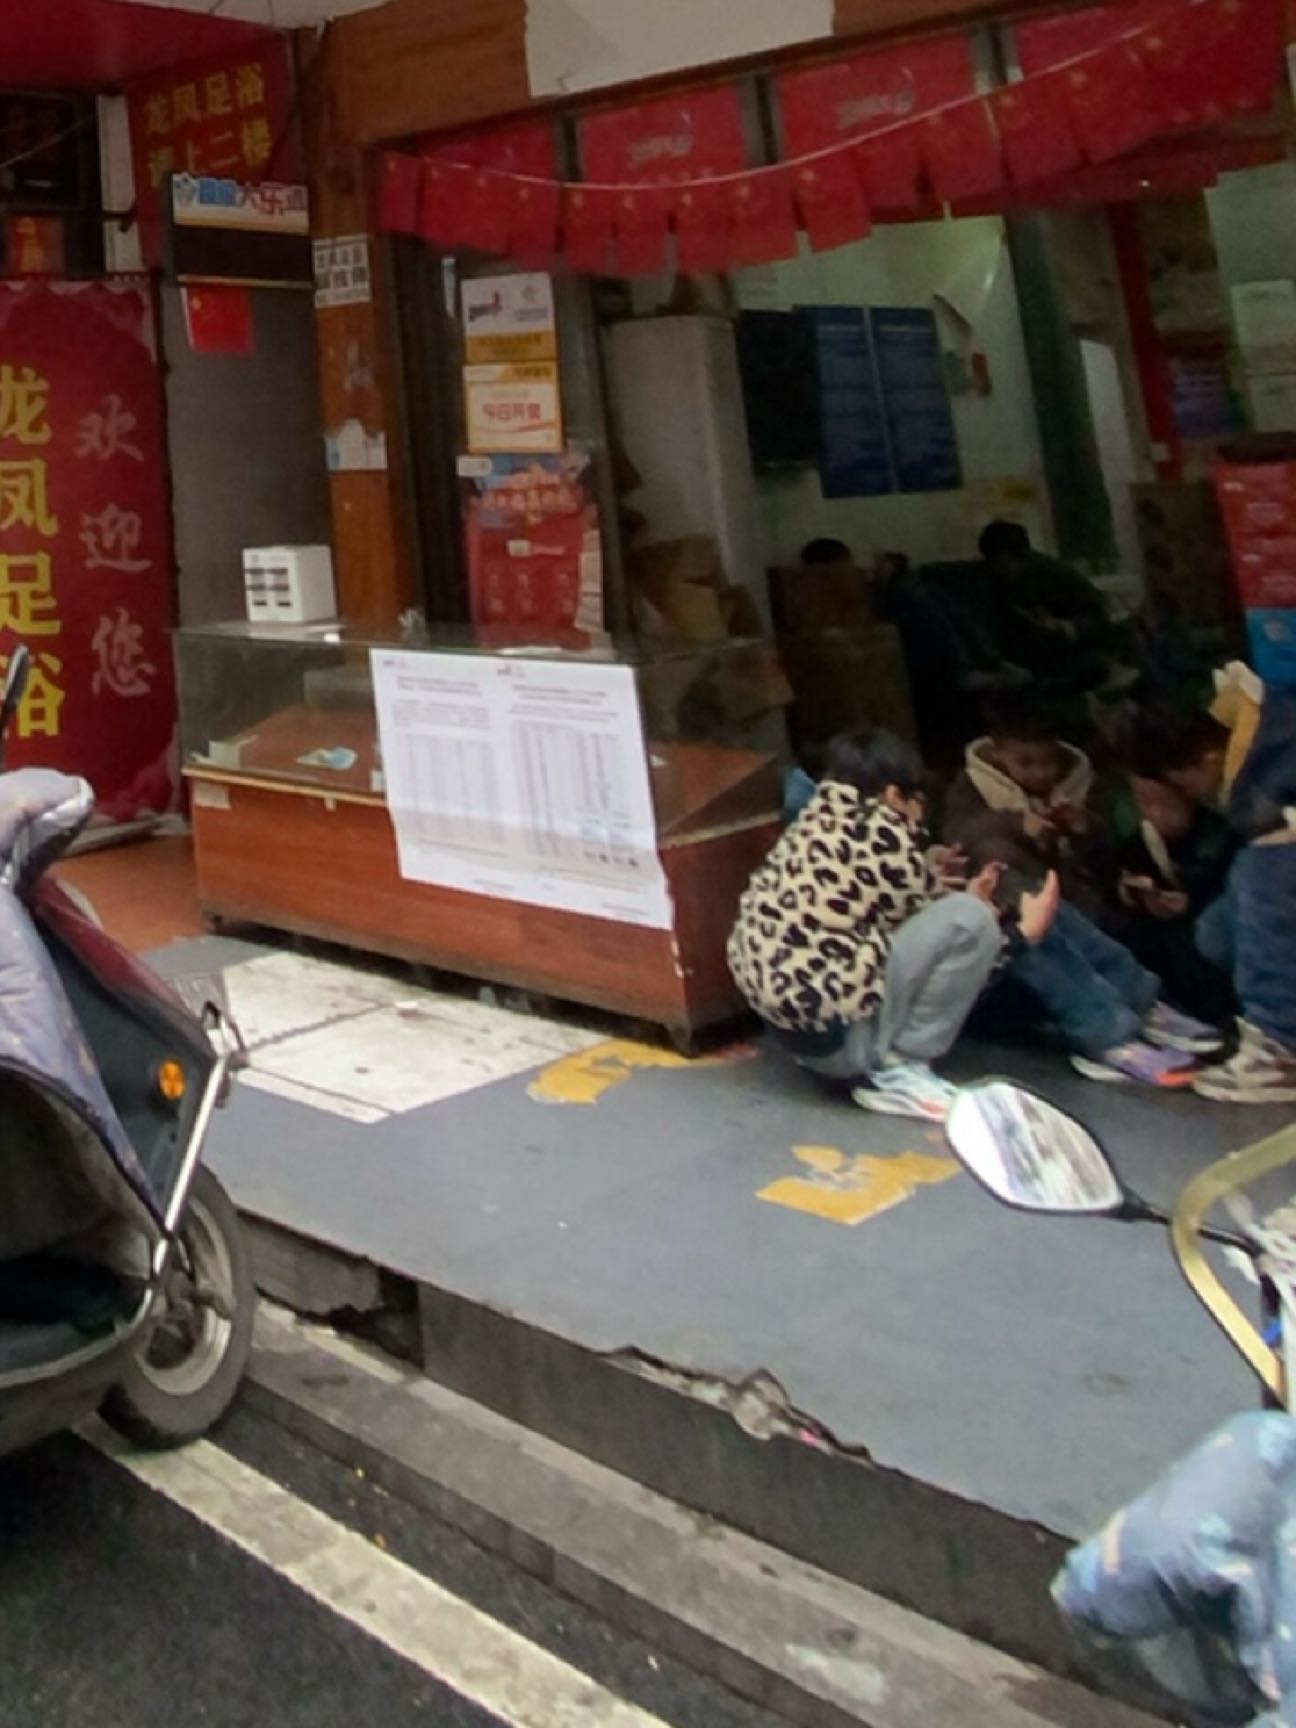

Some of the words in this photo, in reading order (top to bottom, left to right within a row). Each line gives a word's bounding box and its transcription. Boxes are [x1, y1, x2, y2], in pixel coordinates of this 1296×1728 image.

[145, 62, 265, 134] 龙凤足浴
[75, 395, 155, 698] 欢迎您
